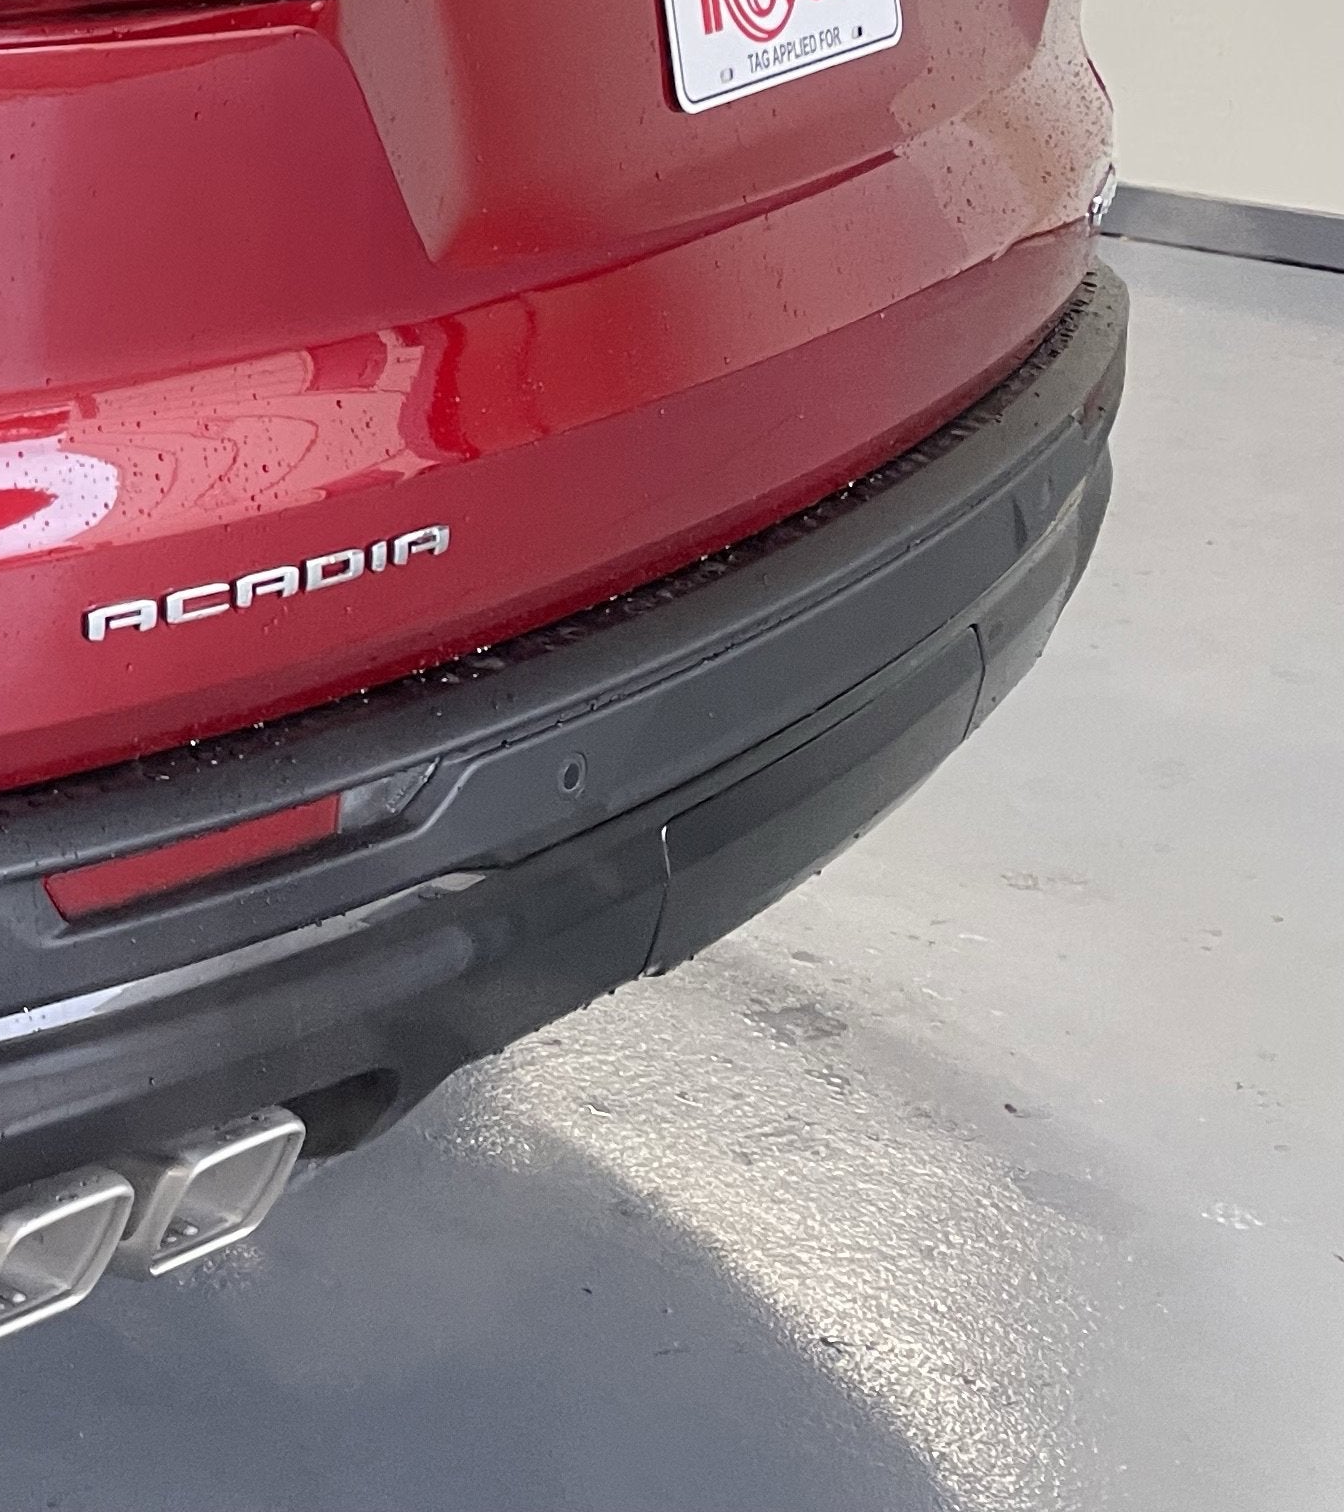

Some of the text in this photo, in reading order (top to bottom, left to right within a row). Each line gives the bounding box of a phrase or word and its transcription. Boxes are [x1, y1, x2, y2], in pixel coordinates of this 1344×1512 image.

[748, 26, 842, 74] TAG APPLIED FOR
[84, 524, 450, 641] ACADIA
